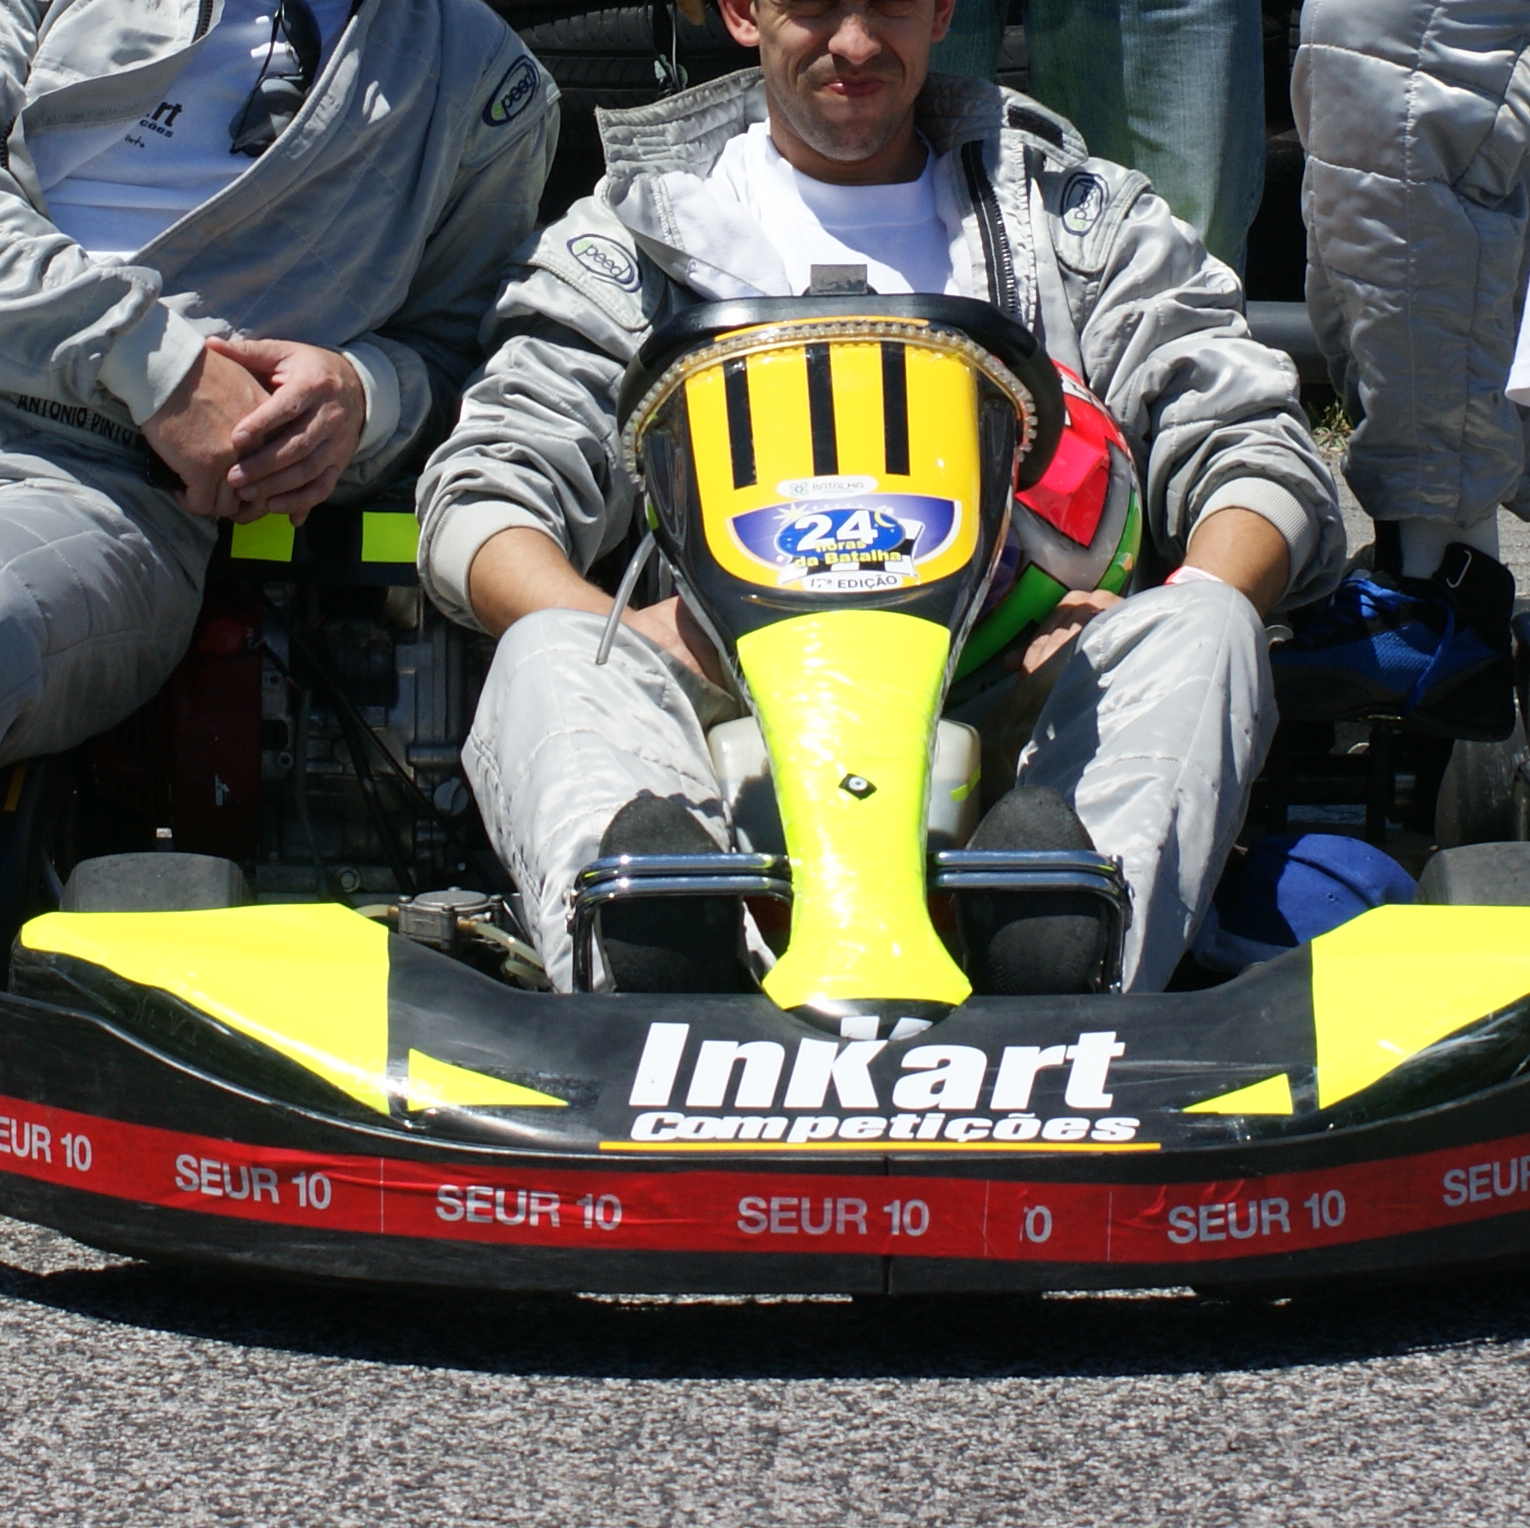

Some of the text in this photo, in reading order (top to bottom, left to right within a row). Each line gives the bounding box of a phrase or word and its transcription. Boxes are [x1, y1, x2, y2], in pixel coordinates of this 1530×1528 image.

[17, 394, 88, 427] ANTONIO
[795, 510, 878, 551] 24
[815, 539, 866, 552] horas
[795, 550, 902, 568] da Batalha
[838, 575, 897, 589] EDIÇÃO
[629, 1022, 1125, 1111] InKart
[630, 1112, 1140, 1143] Competições
[61, 1134, 92, 1172] 10
[176, 1155, 332, 1210] SEUR 10
[436, 1185, 622, 1231] SEUR 10
[737, 1197, 929, 1236] SEUR 10
[1167, 1191, 1346, 1244] SEUR 10
